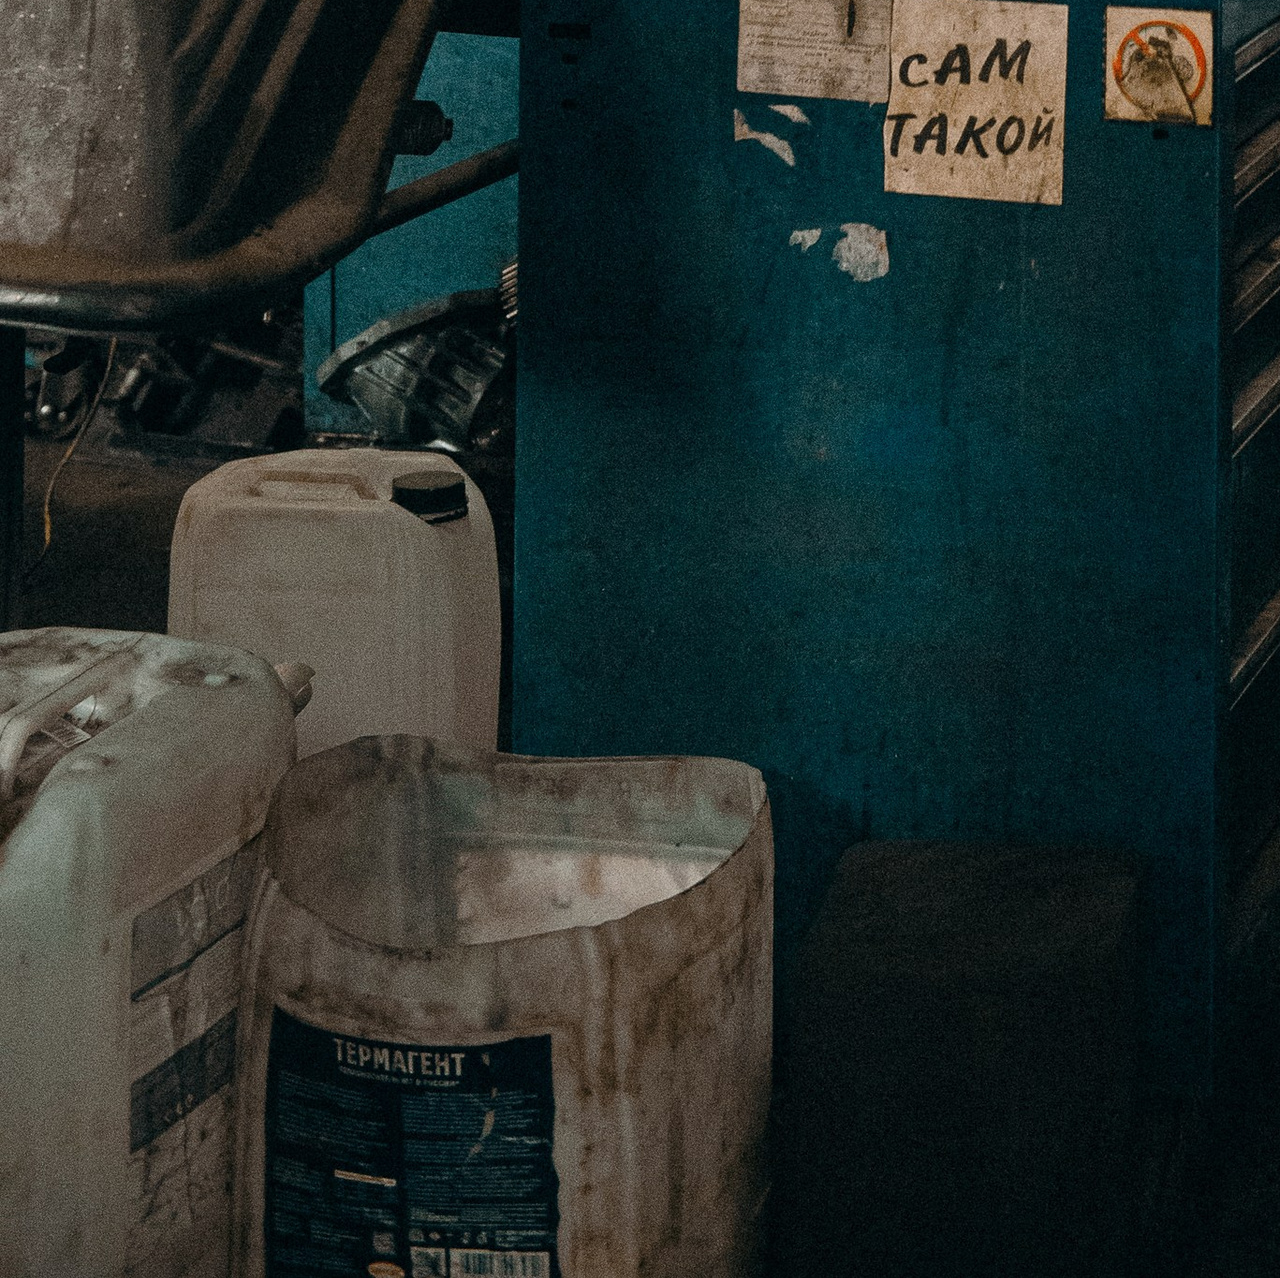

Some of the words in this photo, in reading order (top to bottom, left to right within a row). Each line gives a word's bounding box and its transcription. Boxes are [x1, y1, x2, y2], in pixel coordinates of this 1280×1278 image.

[899, 37, 1032, 88] САМ
[887, 107, 1056, 158] ТАКОЙ
[333, 1037, 465, 1076] ТЕРМАГЕНТ
